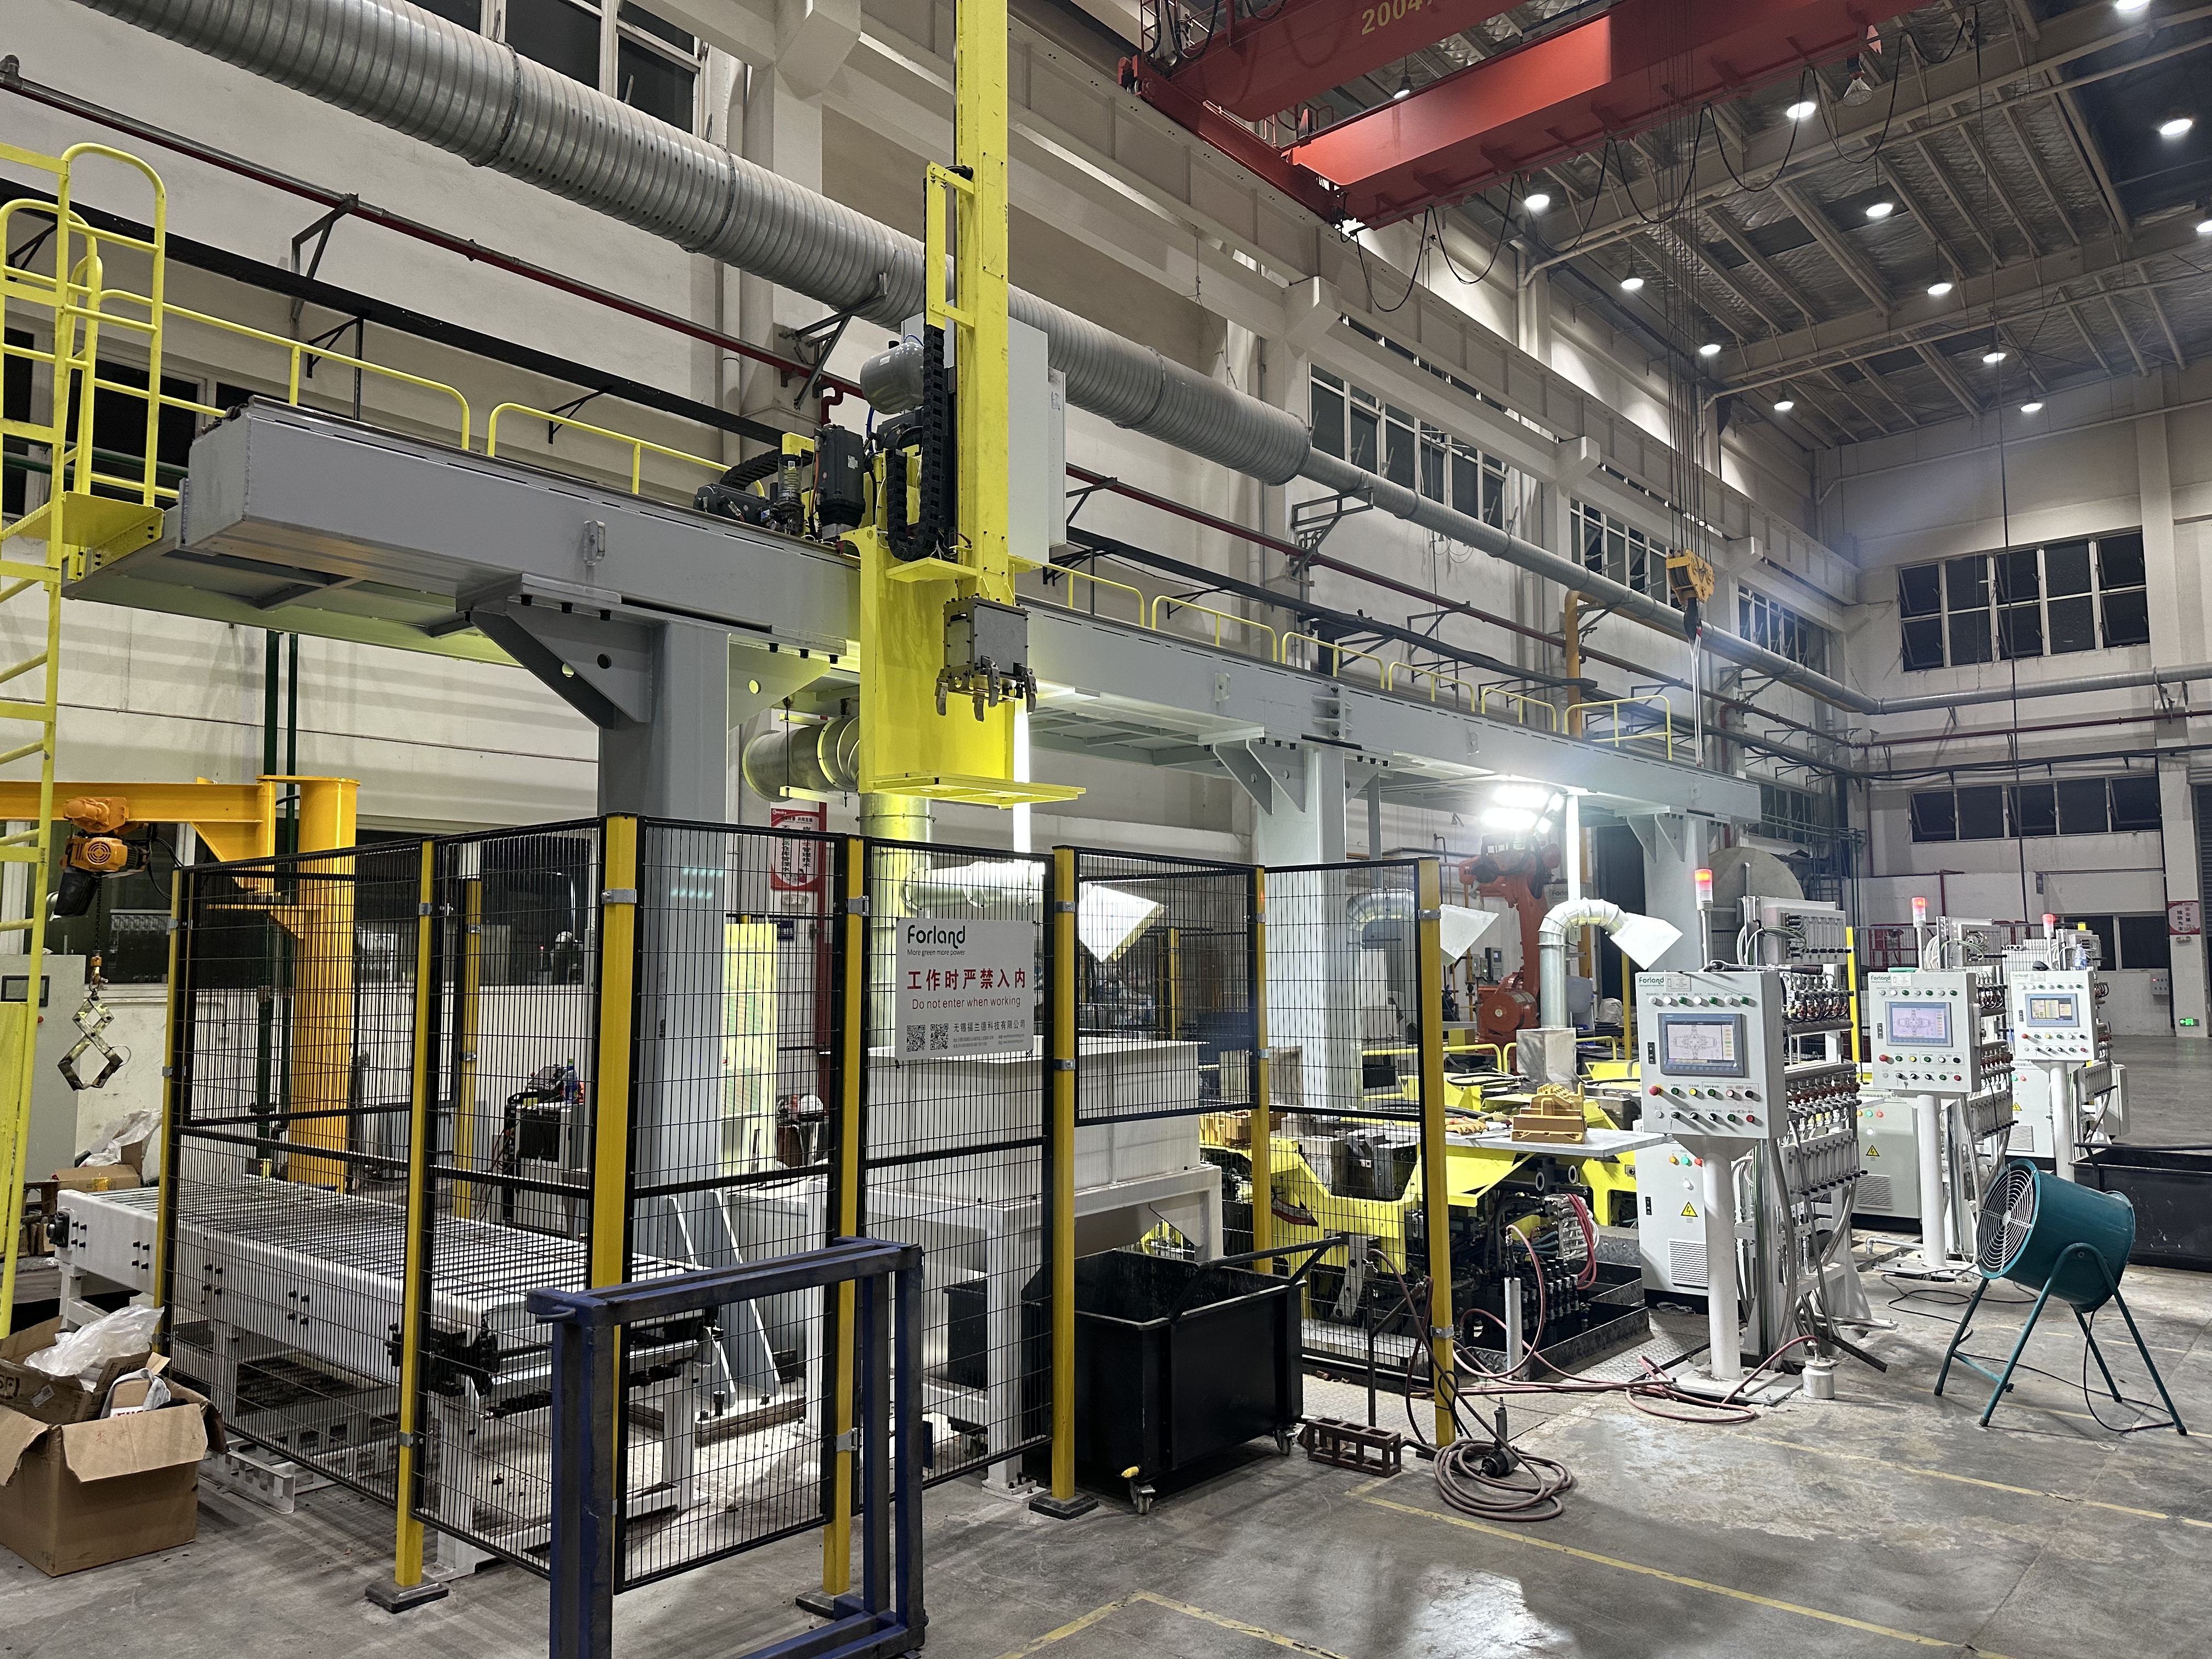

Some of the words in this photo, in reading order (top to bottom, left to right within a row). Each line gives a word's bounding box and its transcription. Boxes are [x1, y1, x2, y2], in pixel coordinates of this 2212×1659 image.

[907, 924, 966, 949] Forland
[907, 968, 1026, 991] 工作时严禁入内
[1639, 977, 1664, 985] Forland
[912, 999, 924, 1010] Do
[927, 999, 941, 1009] not
[943, 998, 964, 1008] enter
[967, 996, 988, 1007] when
[990, 996, 1021, 1007] working
[953, 1019, 1025, 1033] 无锡福兰德科技有限公司
